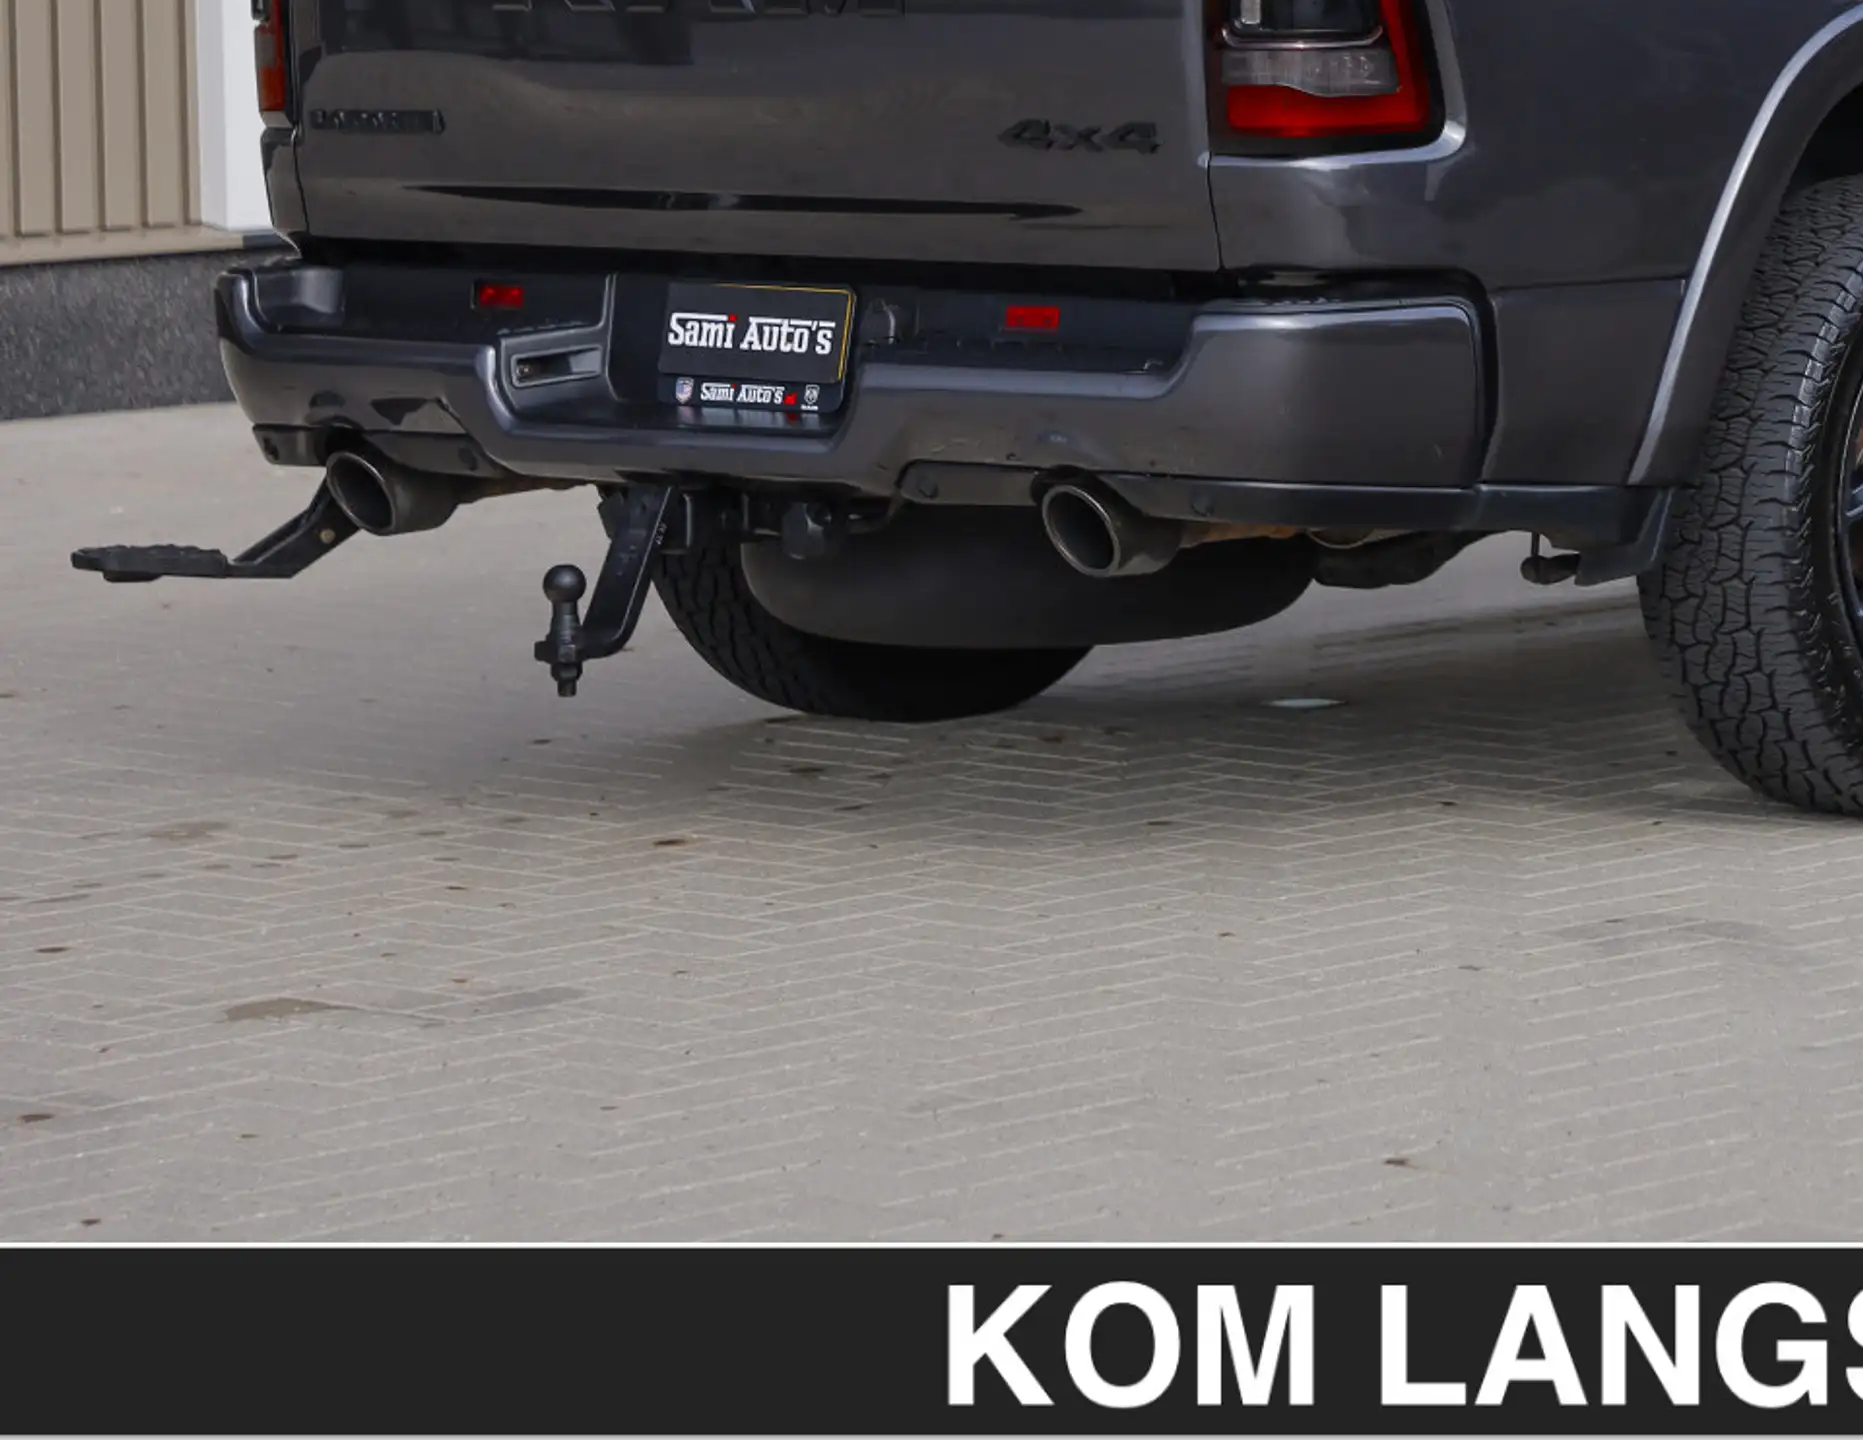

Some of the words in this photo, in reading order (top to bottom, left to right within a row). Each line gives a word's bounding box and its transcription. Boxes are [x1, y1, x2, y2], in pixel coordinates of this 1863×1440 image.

[1000, 117, 1163, 155] 4x4
[668, 312, 738, 349] Sami
[740, 315, 836, 355] Auto's
[700, 382, 737, 401] Sami
